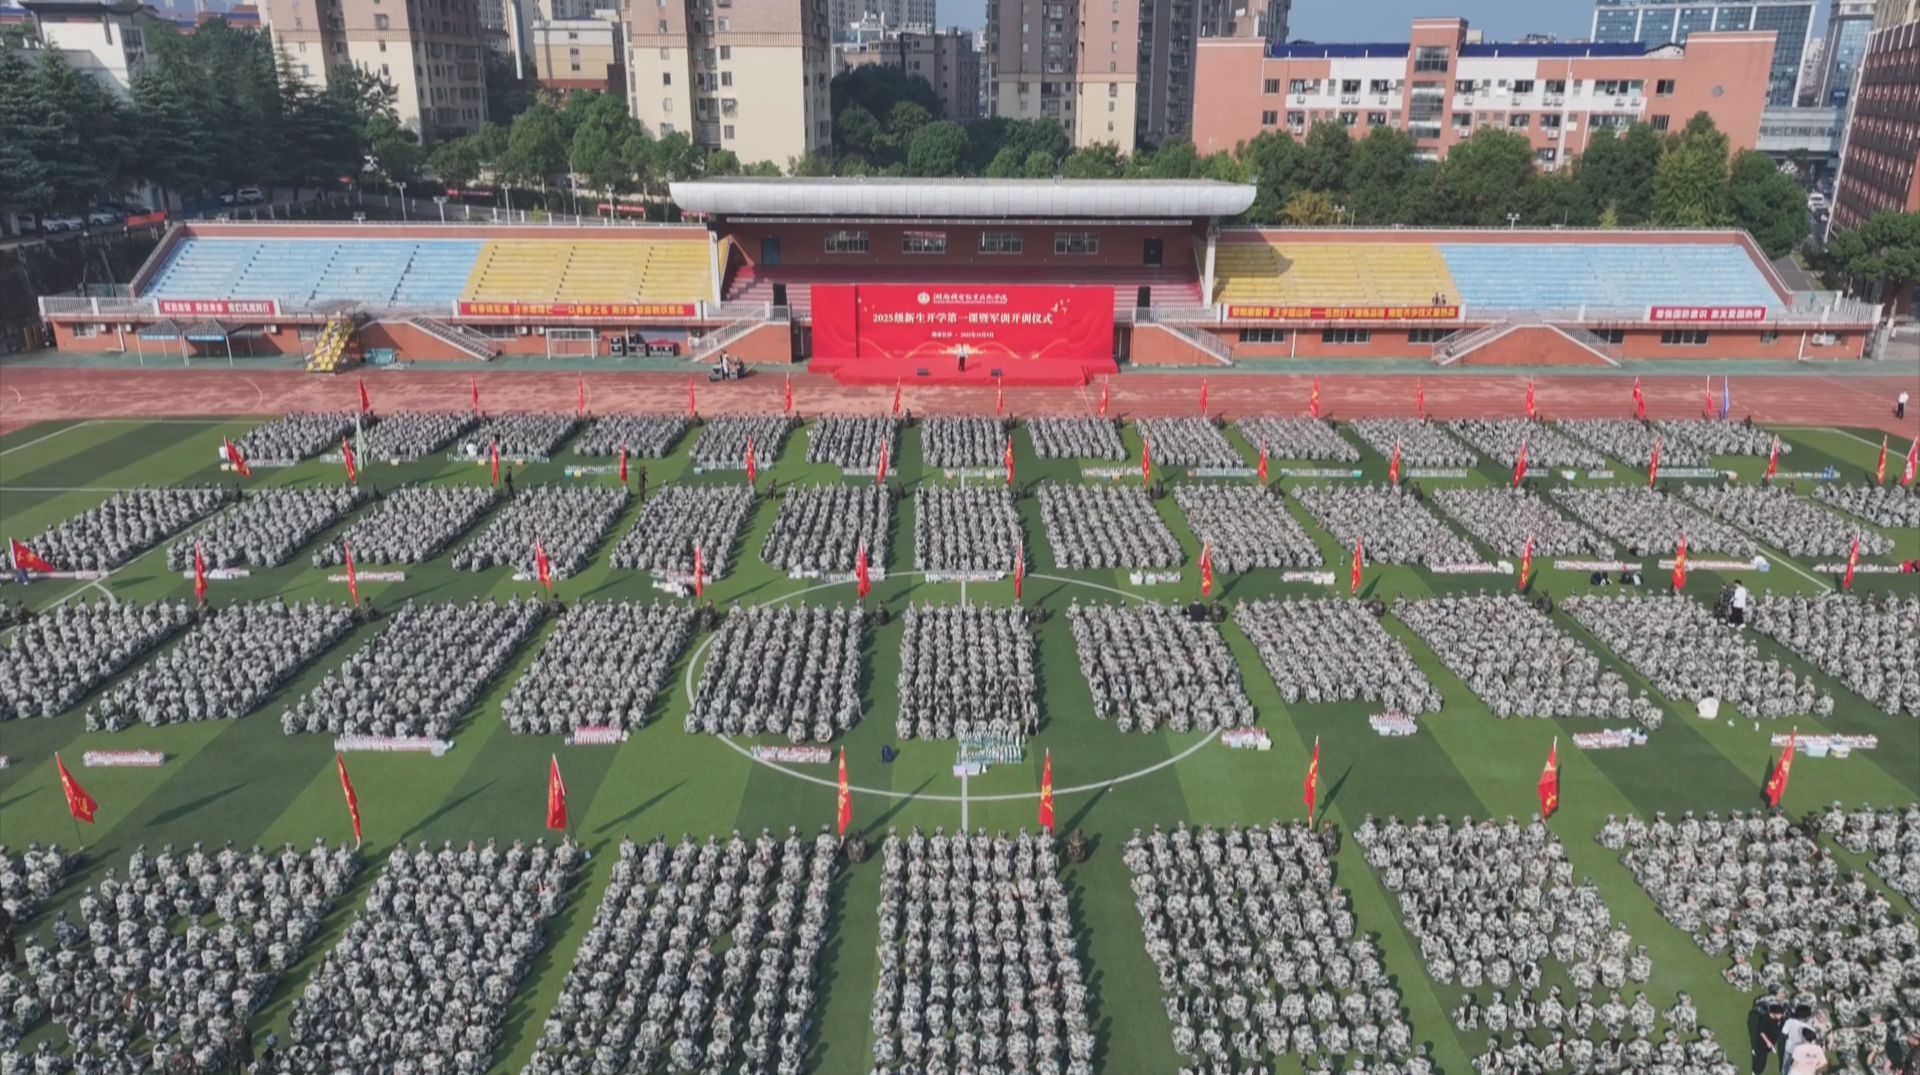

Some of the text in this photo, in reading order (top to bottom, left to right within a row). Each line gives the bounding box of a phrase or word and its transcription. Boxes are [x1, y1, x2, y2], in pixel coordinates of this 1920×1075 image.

[872, 311, 1054, 325] 2025级新生开学第一课暨军训开训仪式
[1655, 308, 1708, 320] 增强国防意识
